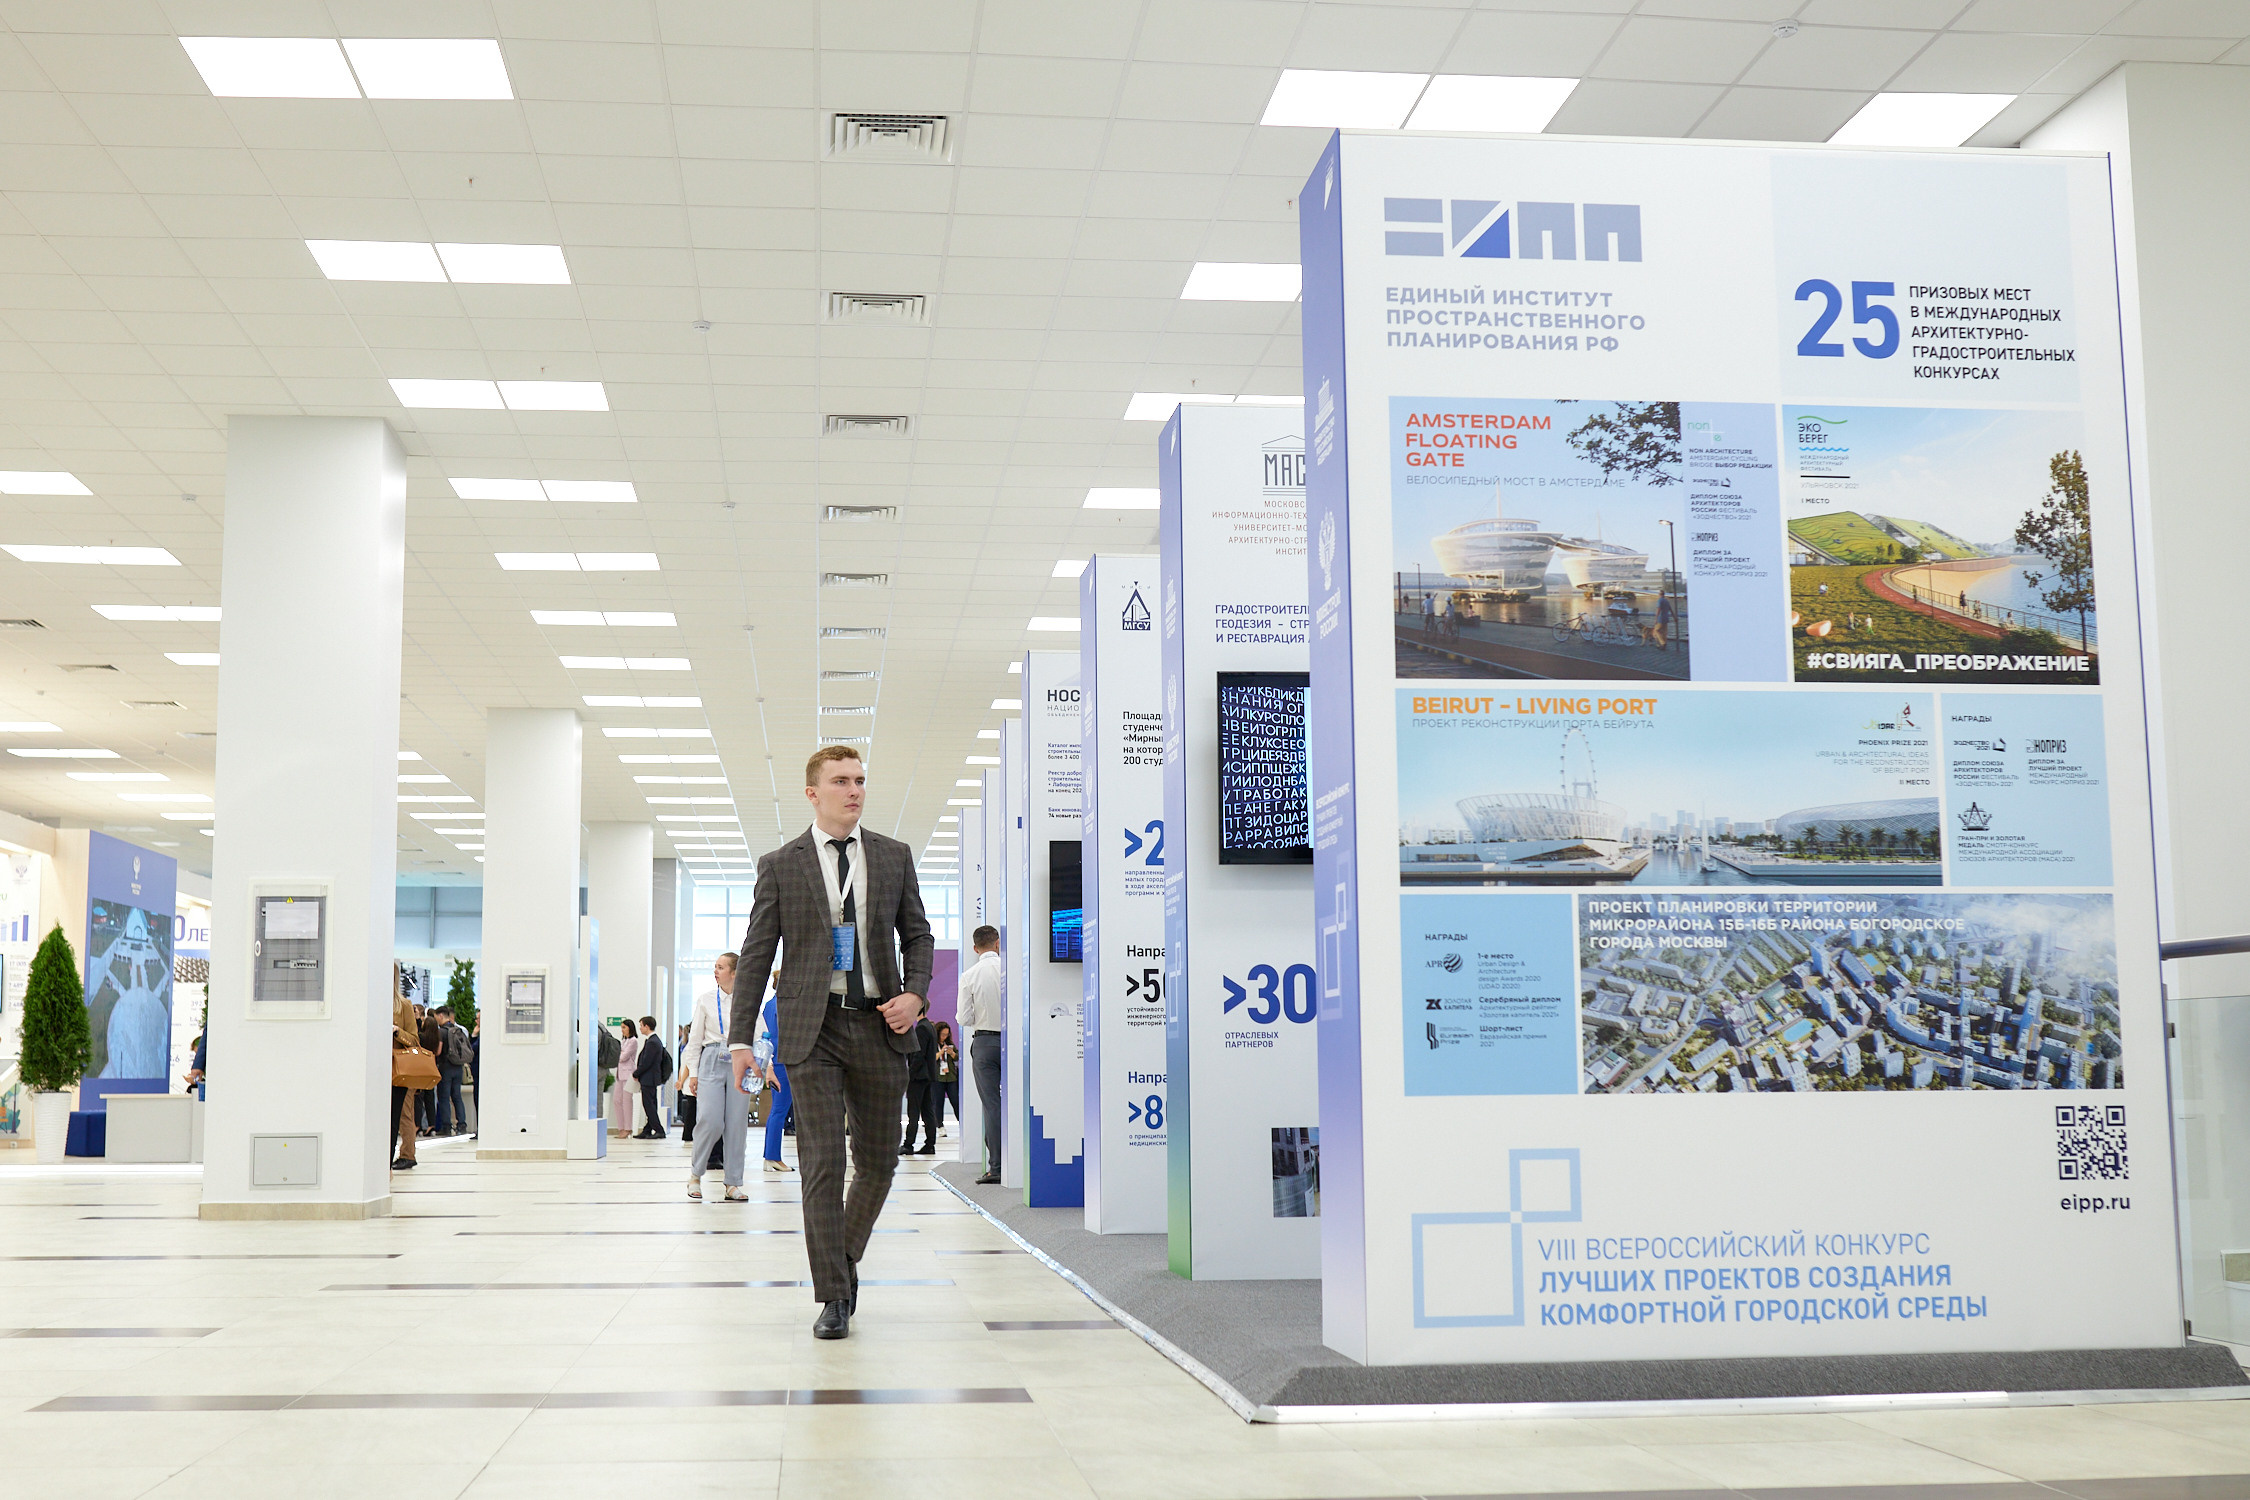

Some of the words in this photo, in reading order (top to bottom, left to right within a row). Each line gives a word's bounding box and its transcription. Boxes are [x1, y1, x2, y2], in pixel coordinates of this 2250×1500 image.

[1386, 285, 1484, 305] ЕДИНЫЙ
[1493, 290, 1613, 309] ИНСТИТУТ
[1909, 286, 1988, 300] ПРИЗОВЫХ
[1994, 288, 2031, 301] МЕСТ
[1386, 309, 1645, 331] ПРОСТРАНСТВЕННОГО
[1794, 278, 1900, 360] 25
[1911, 306, 1920, 318] В
[1924, 306, 2061, 322] МЕЖДУНАРОДНЫХ
[1911, 326, 2029, 341] АРХИТЕКТУРНО-
[1387, 332, 1578, 352] ПЛАНИРОВАНИЯ
[1586, 336, 1619, 353] РФ
[1912, 346, 2076, 362] ГРАДОСТРОИТЕЛЬНЫХ
[1914, 366, 2000, 380] КОНКУРСАХ
[1406, 413, 1551, 430] AMSTERDAM
[1687, 421, 1710, 430] non
[1798, 423, 1821, 433] ЭКО
[1405, 433, 1517, 449] FLOATING
[1799, 434, 1828, 443] БЕРЕГ
[1406, 452, 1465, 467] GATE
[1406, 474, 1499, 488] ВЕЛОСИПЕДНЫЙ
[1503, 477, 1535, 487] МОСТ
[1539, 478, 1546, 487] В
[1549, 478, 1625, 489] АМСТЕРДАМЕ
[1215, 604, 1309, 615] ГРАДОСТРОИТЕЛ
[1123, 622, 1150, 630] МГСУ
[1215, 619, 1272, 630] ГЕОДЕЗИЯ
[1216, 633, 1224, 643] И
[1227, 633, 1305, 644] РЕСТАВРАЦИЯ
[1807, 652, 2090, 673] #СВИЯГА_ПРЕОБРАЖЕНИЕ
[1412, 697, 1494, 714] BEIRUT
[1517, 697, 1591, 715] LIVING
[1598, 698, 1658, 715] PORT
[1123, 711, 1163, 721] Площад
[1412, 718, 1457, 728] ПРОЕКТ
[1461, 719, 1560, 730] РЕКОНСТРУКЦИИ
[1563, 719, 1600, 729] ПОРТА
[1603, 718, 1655, 730] БЕЙРУТА
[2034, 739, 2067, 753] НОПРИЗ
[1123, 756, 1141, 765] 200
[1588, 900, 1653, 914] ПРОЕКТ
[1658, 900, 1769, 914] ПЛАНИРОВКИ
[1774, 900, 1877, 914] ТЕРРИТОРИИ
[1589, 914, 1714, 932] МИКРОРАЙОНА
[1718, 917, 1777, 931] 15Б-16Б
[1780, 915, 1846, 932] РАЙОНА
[1849, 917, 1964, 933] БОГОРОДСКОЕ
[187, 928, 212, 942] ЛЕ
[1589, 935, 1655, 952] ГОРОДА
[1659, 935, 1728, 949] МОСКВЫ
[1425, 960, 1443, 968] APR
[1126, 968, 1166, 1003] >5
[1478, 975, 1500, 983] design
[1222, 963, 1317, 1024] >30
[1479, 996, 1530, 1004] Серебряный
[1531, 996, 1561, 1004] диплом
[1224, 1031, 1279, 1040] ОТРАСЛЕВЫХ
[1479, 1025, 1523, 1033] Шорт-лист
[1225, 1040, 1274, 1048] ПАРТНЕРОВ
[1128, 1094, 1168, 1130] >8
[2060, 1195, 2131, 1214] eipp.ru
[1538, 1238, 1577, 1262] VIII
[1586, 1230, 1806, 1262] ВСЕРОССИЙСКИЙ
[1815, 1232, 1931, 1258] КОНКУРС
[1538, 1268, 1656, 1294] ЛУЧШИХ
[1664, 1266, 1800, 1291] ПРОЕКТОВ
[1808, 1263, 1952, 1292] СОЗДАНИЯ
[1540, 1295, 1726, 1327] КОМФОРТНОЙ
[1734, 1292, 1889, 1325] ГОРОДСКОЙ
[1898, 1295, 1989, 1321] СРЕДЫ
